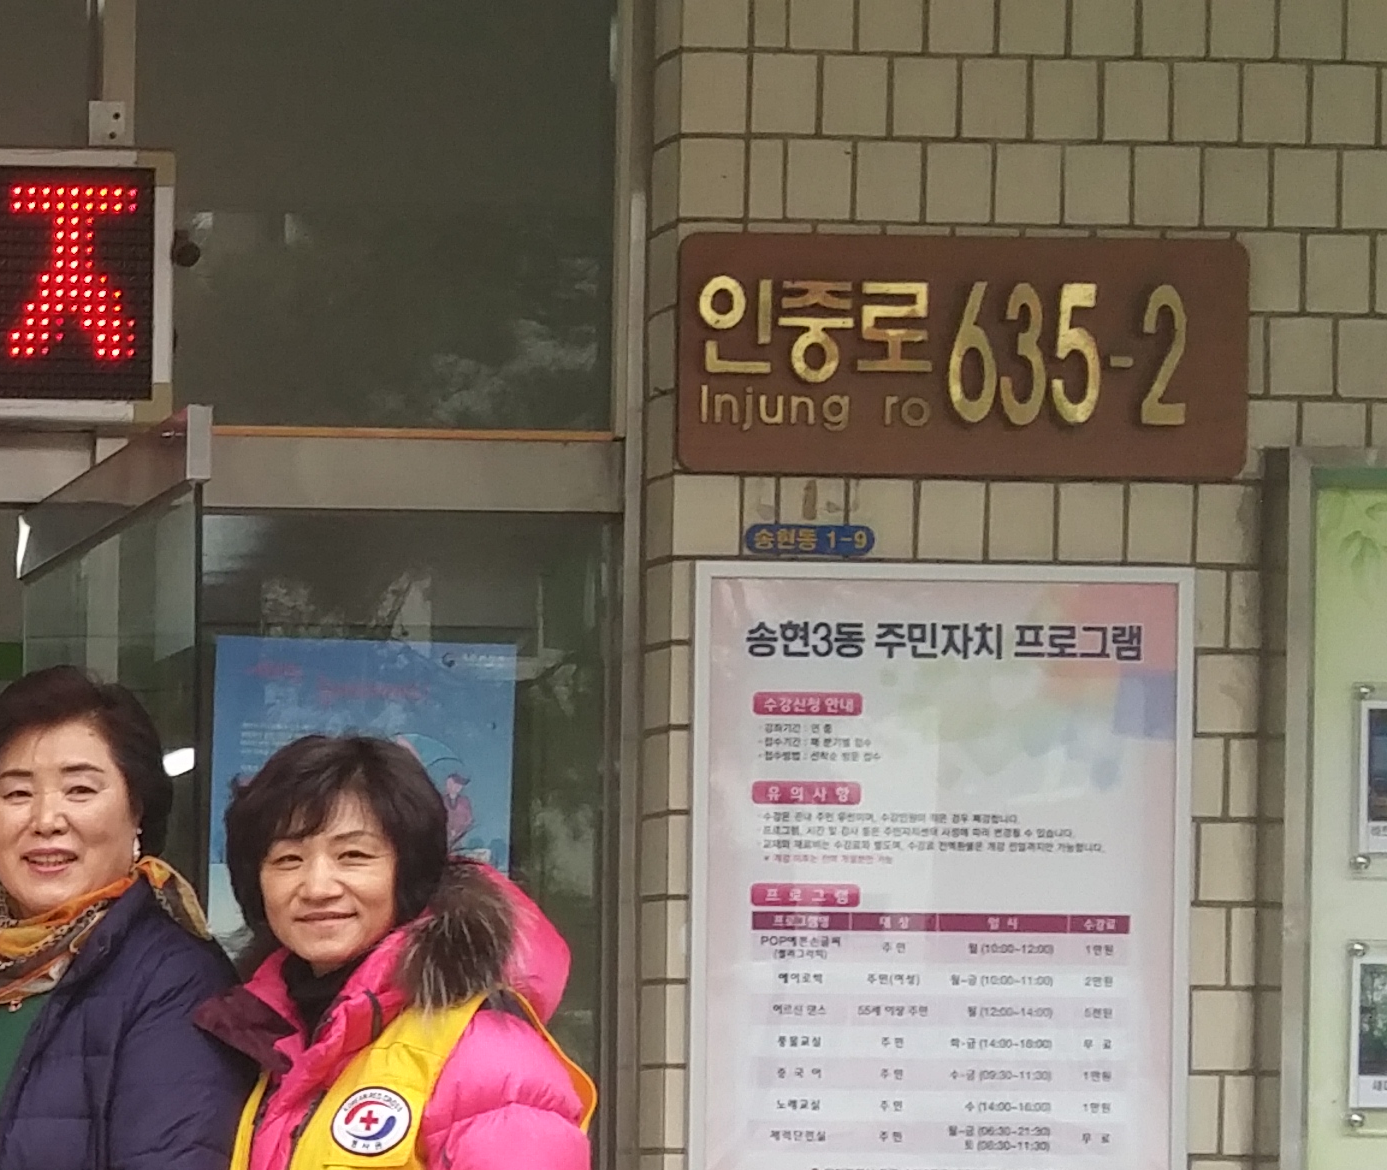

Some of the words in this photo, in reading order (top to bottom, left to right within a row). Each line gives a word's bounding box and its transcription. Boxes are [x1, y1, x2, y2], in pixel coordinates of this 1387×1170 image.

[698, 275, 933, 384] 인중로
[948, 280, 1188, 426] 635-2
[699, 384, 851, 432] Injung
[883, 394, 931, 428] ro
[753, 529, 818, 551] 송현동
[826, 530, 868, 550] 1-9
[746, 620, 866, 658] 송현3동
[874, 622, 1004, 661] 주민자치
[1014, 624, 1144, 662] 프로그램
[764, 697, 820, 713] 수강신청
[825, 697, 854, 713] 안내
